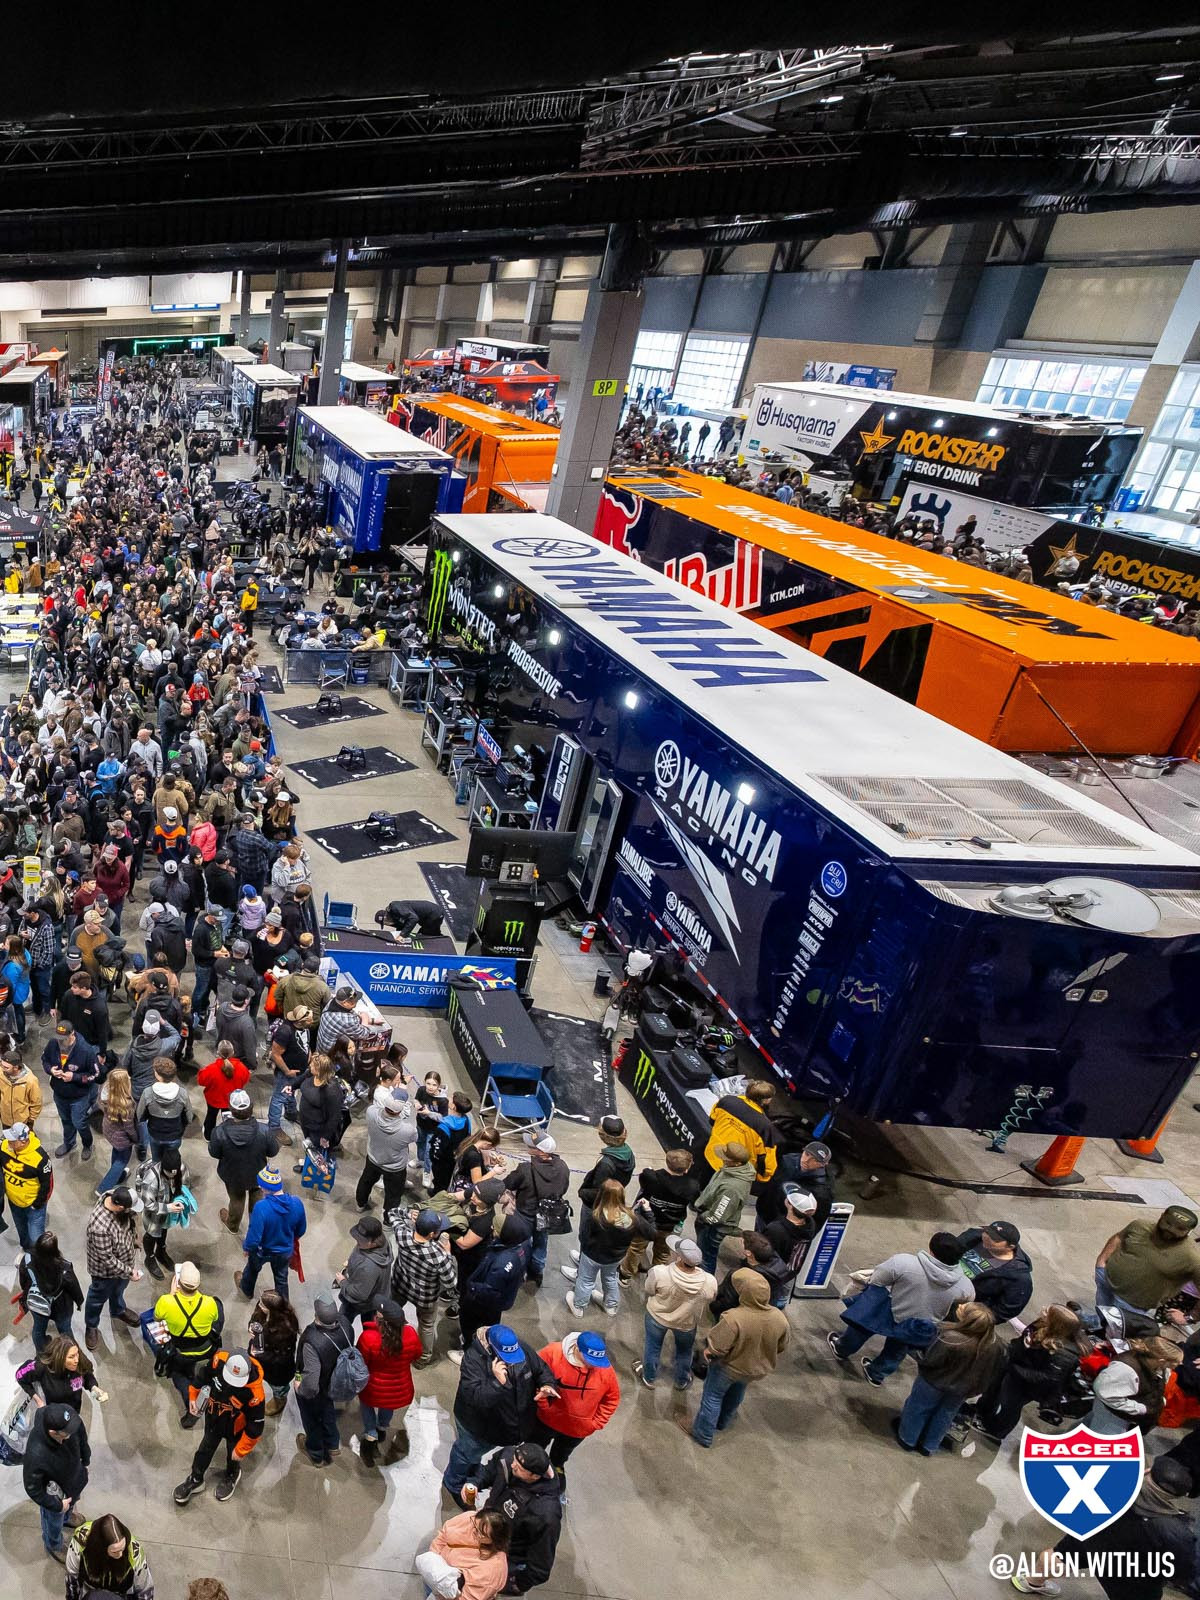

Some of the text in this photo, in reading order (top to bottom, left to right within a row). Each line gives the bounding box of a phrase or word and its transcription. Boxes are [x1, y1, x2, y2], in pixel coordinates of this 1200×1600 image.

[598, 381, 612, 394] 8P
[770, 407, 837, 437] Husqvarna
[898, 429, 1006, 471] ROCKSTAR
[942, 466, 982, 487] DRINK
[770, 584, 805, 602] KTM.COM
[448, 584, 497, 647] MONSTER
[529, 561, 829, 688] YAMAHA
[451, 617, 485, 655] ENERGY
[507, 640, 563, 700] PROGRESSIVE
[478, 723, 502, 759] PARTS
[655, 786, 758, 887] RACING
[680, 757, 782, 884] YAMAHA
[620, 837, 656, 888] YAMALUBE
[677, 900, 713, 954] YAMAHA
[803, 921, 825, 941] DUNLOP
[808, 900, 833, 928] PROTAPER
[662, 911, 707, 967] FINANCIAL SERVICES
[369, 983, 449, 997] FINANCIAL SERVIC
[392, 964, 449, 983] YAMAH
[652, 1080, 695, 1147] MONSTER
[655, 1100, 686, 1143] ENERGY
[4, 1171, 28, 1188] FOX
